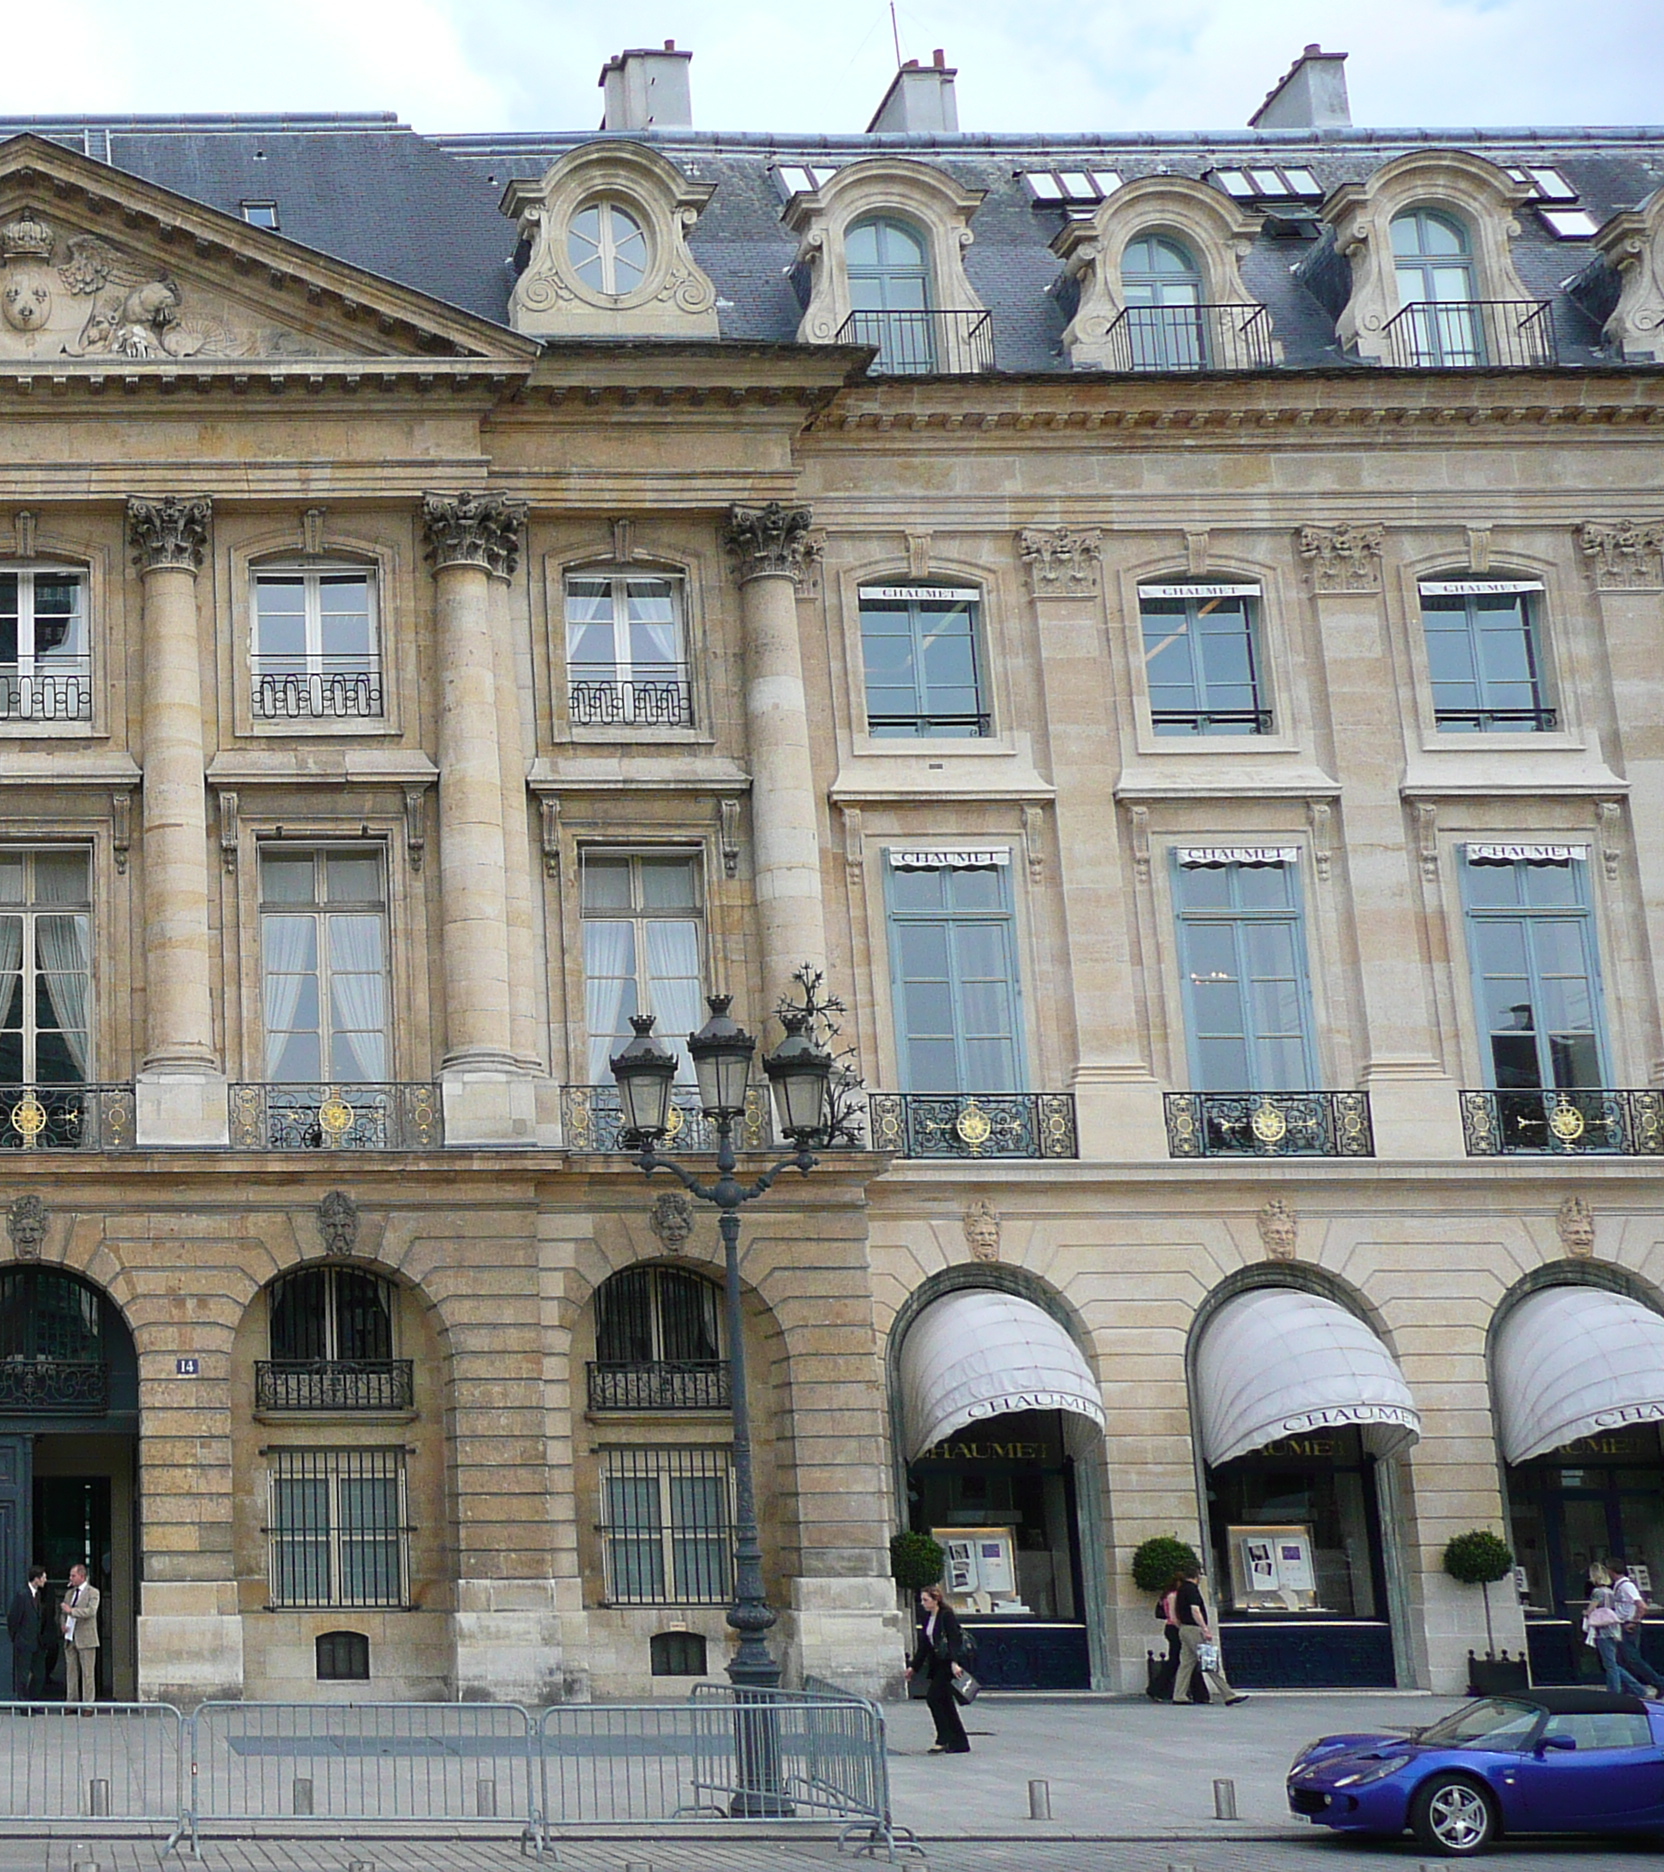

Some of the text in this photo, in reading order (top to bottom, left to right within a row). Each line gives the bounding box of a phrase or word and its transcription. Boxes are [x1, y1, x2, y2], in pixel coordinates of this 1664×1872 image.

[882, 588, 957, 599] CHAUMET
[1162, 586, 1238, 596] CHAUMET
[1187, 848, 1284, 859] CHAUMET
[1478, 845, 1576, 857] CHAUMET
[901, 852, 997, 863] CHAUMET
[180, 1360, 195, 1373] 14
